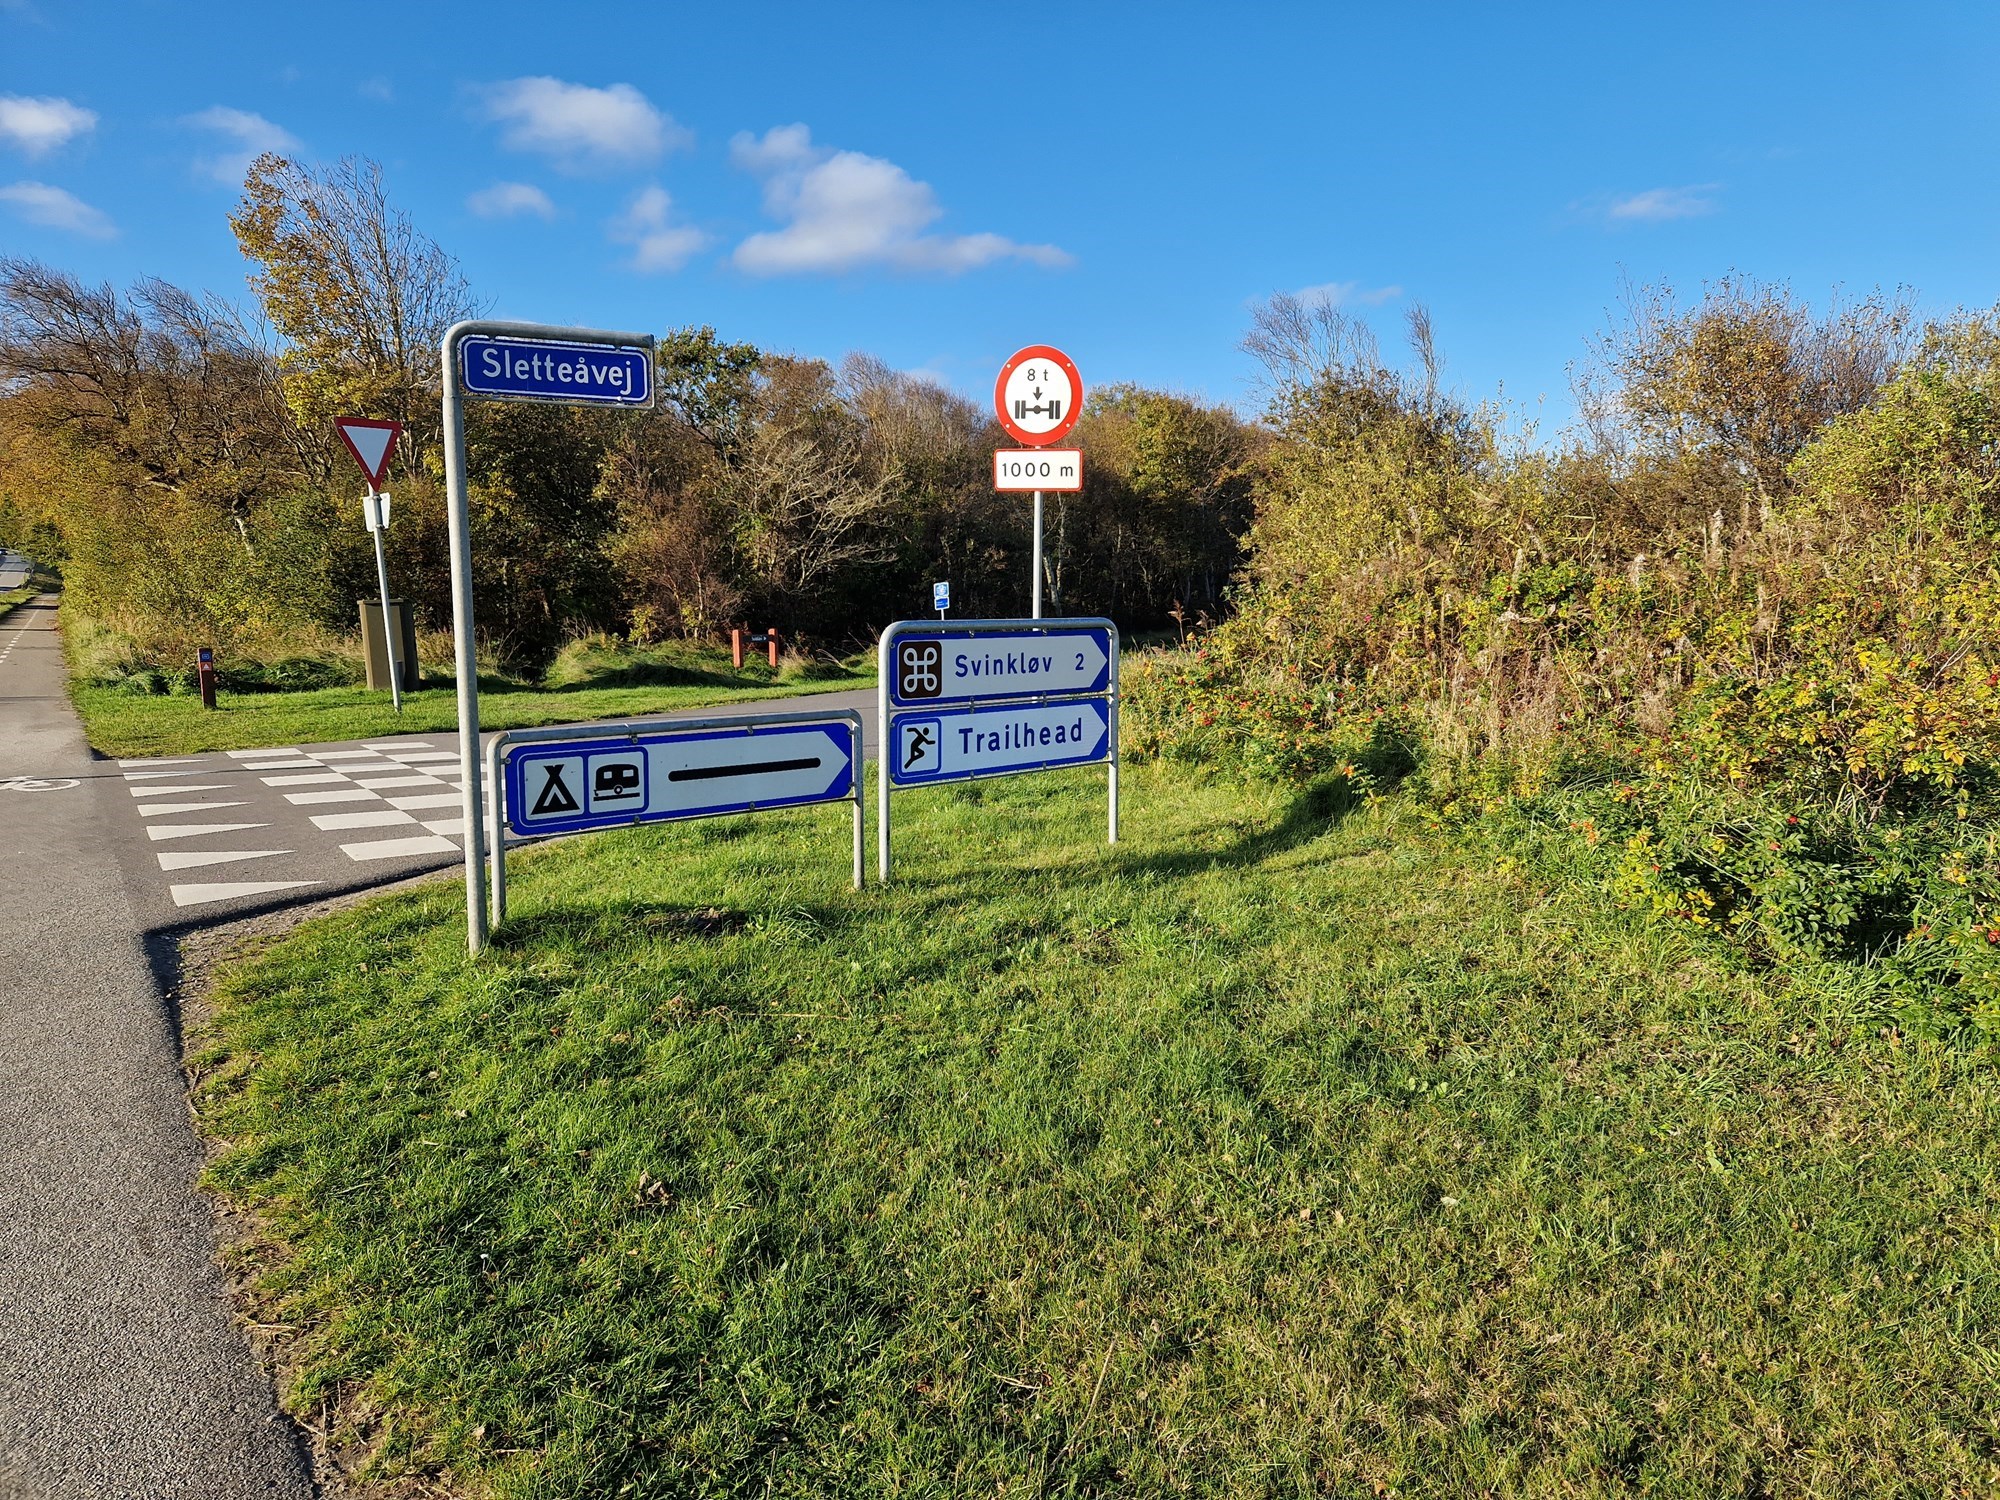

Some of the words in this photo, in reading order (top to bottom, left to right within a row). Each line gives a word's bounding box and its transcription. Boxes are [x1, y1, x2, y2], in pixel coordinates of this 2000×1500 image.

[482, 348, 632, 396] Sletteåvej
[1027, 368, 1036, 381] 8
[1043, 369, 1049, 381] t
[1002, 462, 1050, 477] 1000
[1060, 465, 1073, 477] m
[955, 652, 1052, 678] Svinkløv
[1075, 653, 1084, 671] 2
[958, 717, 1082, 755] Trailhead
